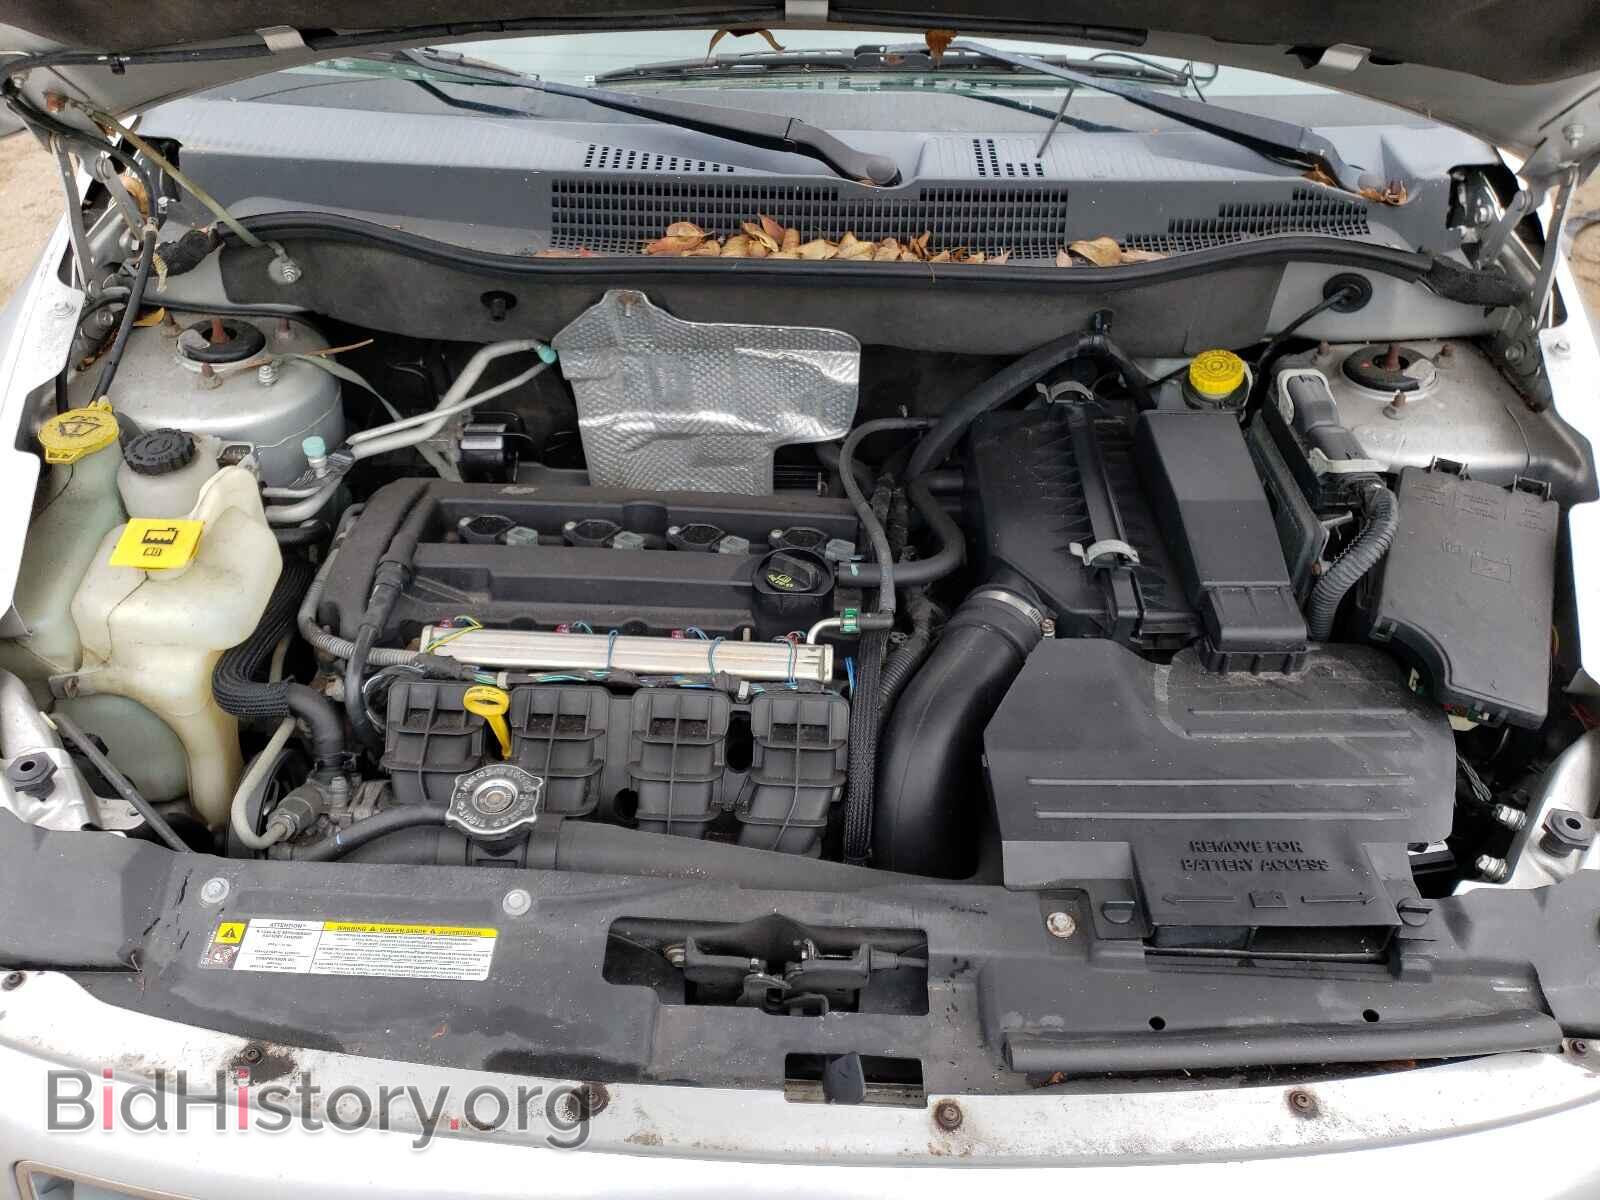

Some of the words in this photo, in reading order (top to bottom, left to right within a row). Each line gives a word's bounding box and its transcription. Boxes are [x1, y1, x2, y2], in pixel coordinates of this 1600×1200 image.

[1189, 840, 1264, 853] REMOVE
[1266, 840, 1304, 853] FOR
[1180, 859, 1253, 872] BATTERY
[1260, 859, 1330, 872] ACCESS
